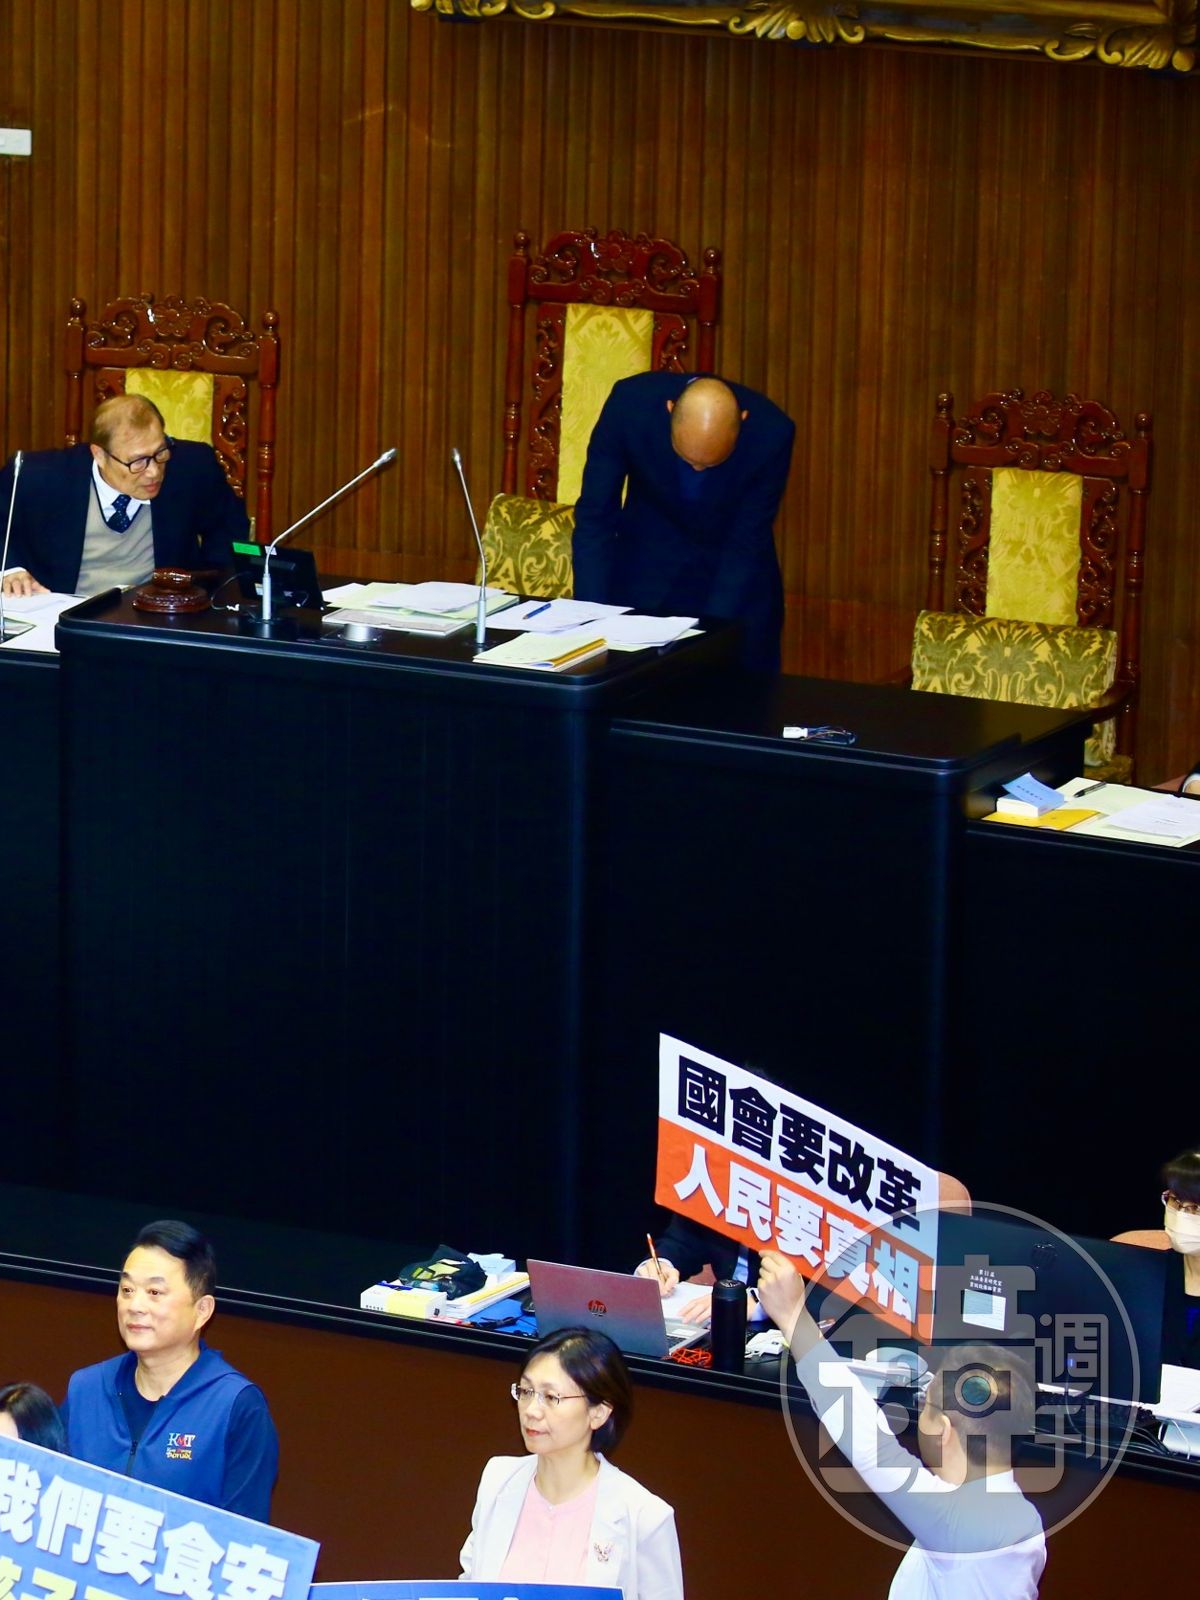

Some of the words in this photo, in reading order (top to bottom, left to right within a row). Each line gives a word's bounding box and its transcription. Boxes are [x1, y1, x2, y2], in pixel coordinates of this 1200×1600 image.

[678, 1055, 921, 1231] 國會要改革
[673, 1143, 920, 1324] 人民要真相
